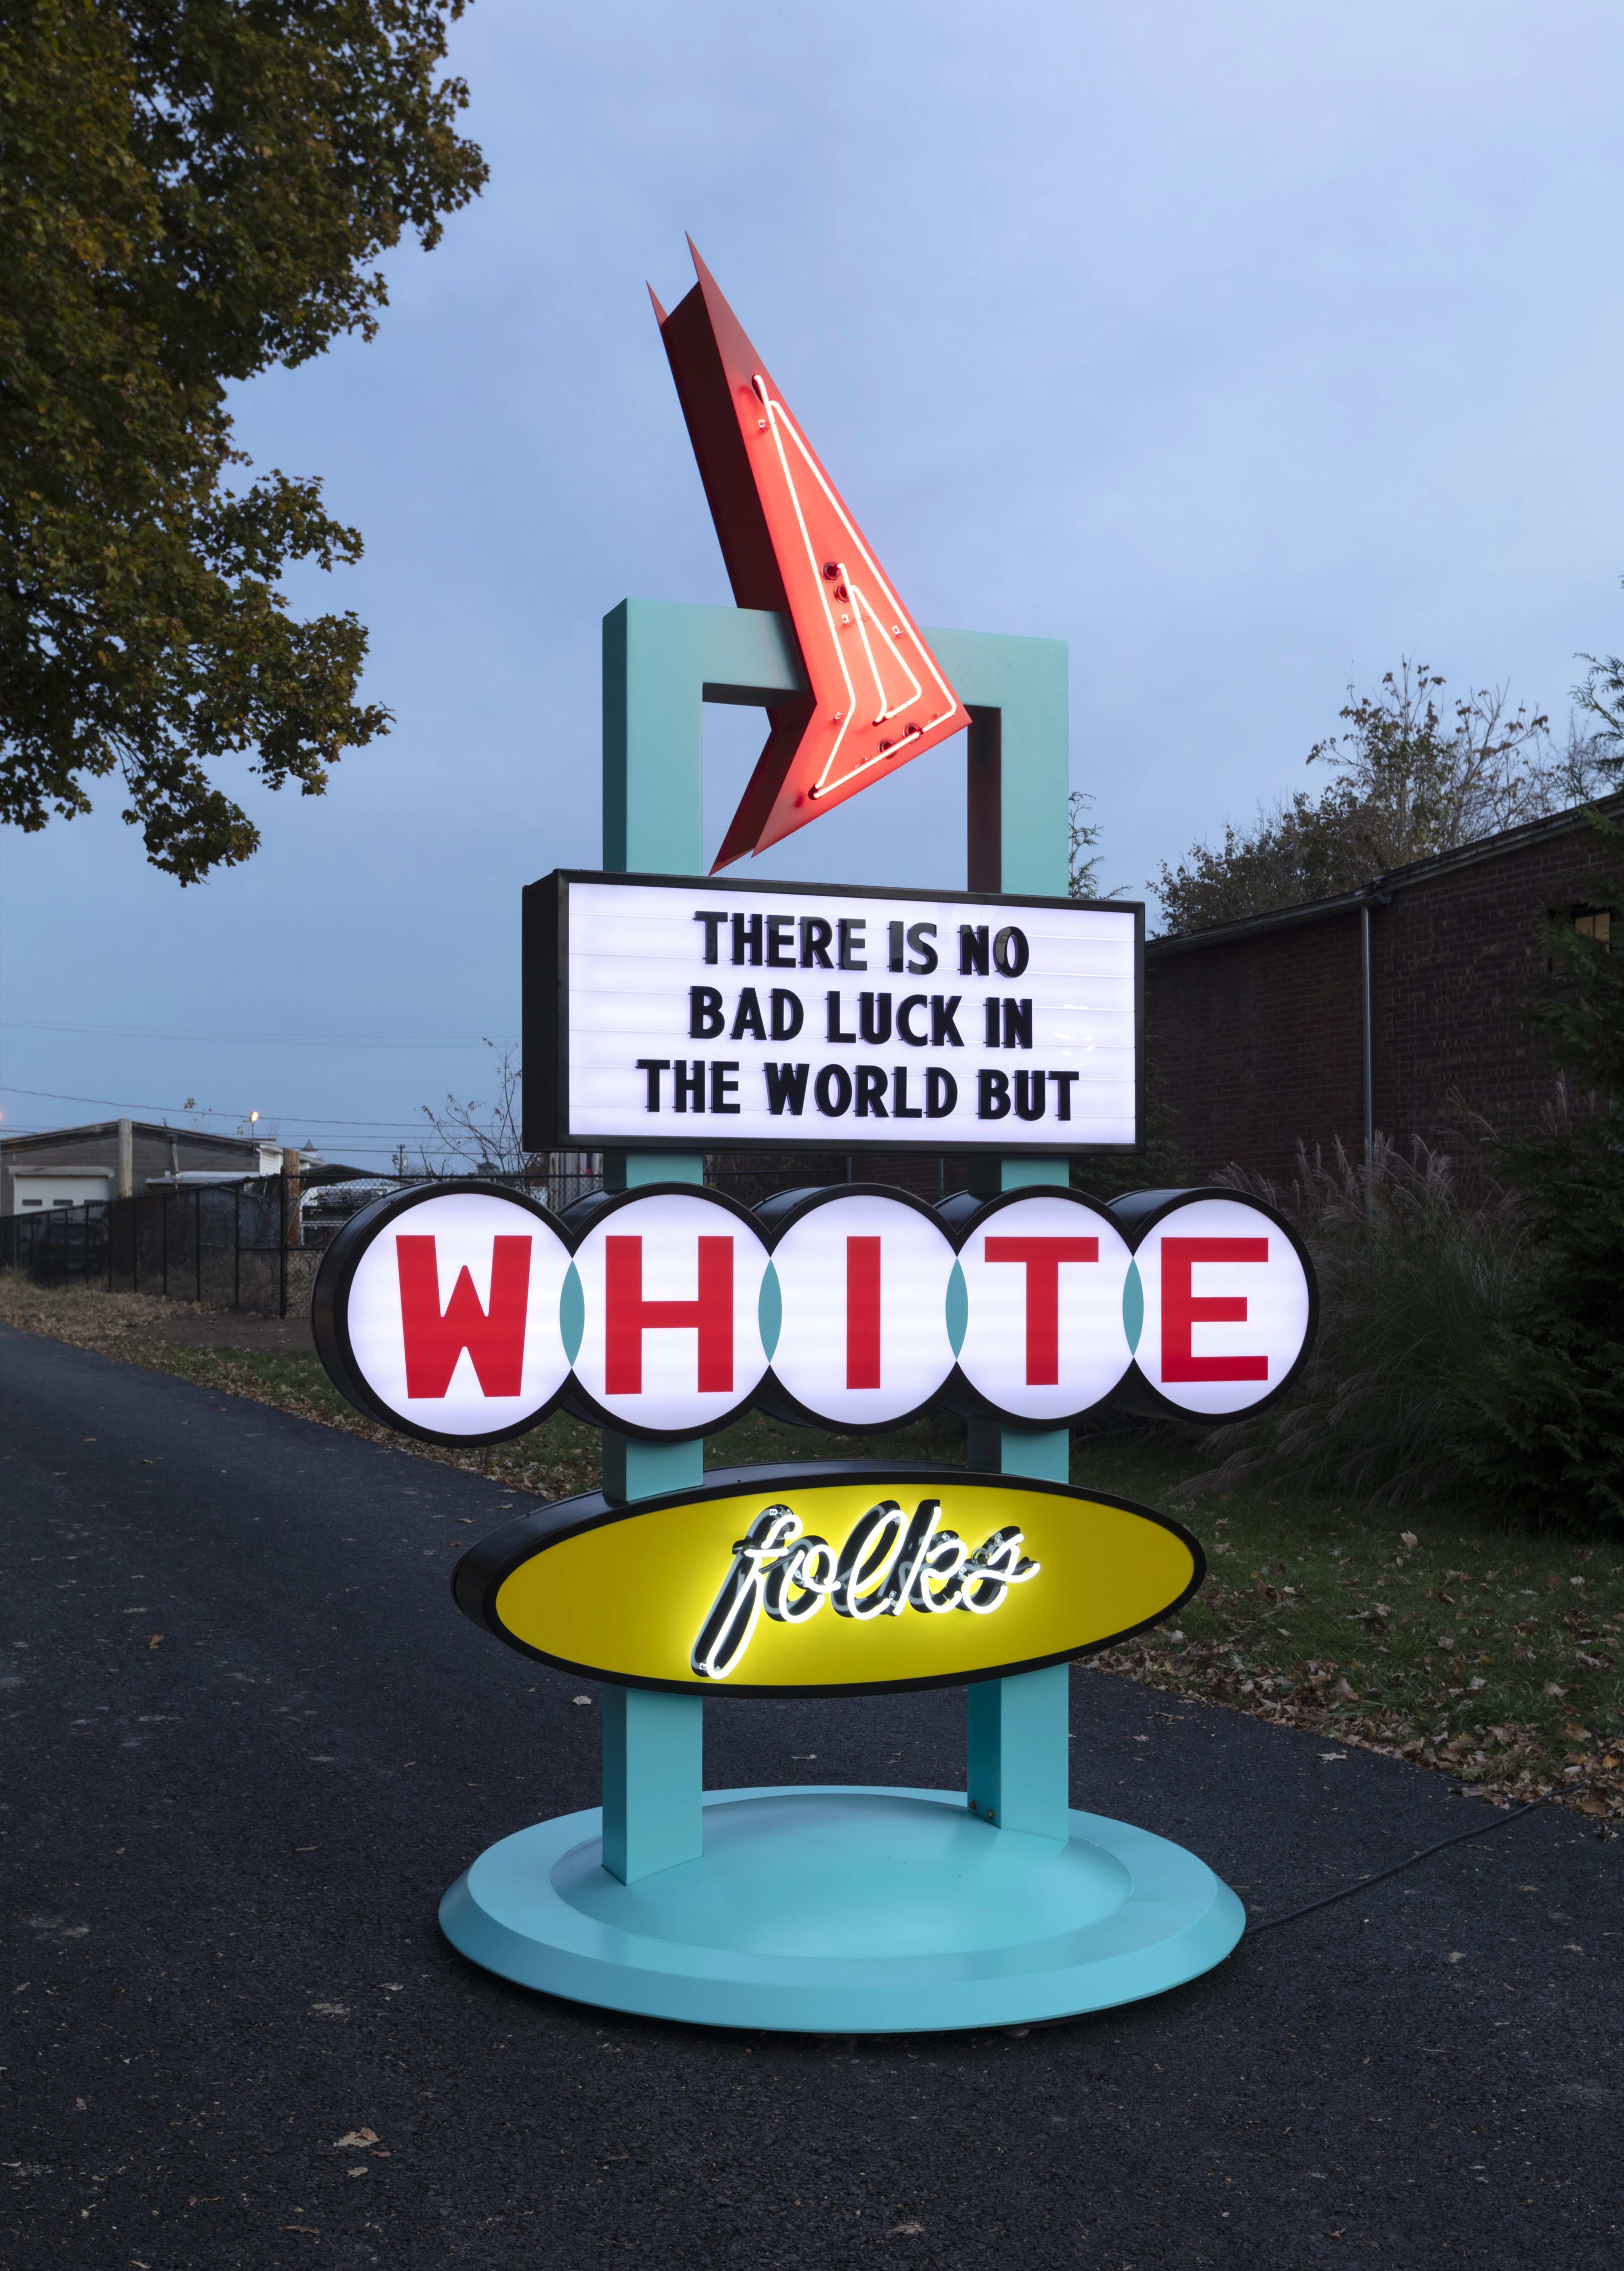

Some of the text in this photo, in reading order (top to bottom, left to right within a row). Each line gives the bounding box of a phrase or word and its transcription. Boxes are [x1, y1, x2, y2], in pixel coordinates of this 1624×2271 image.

[693, 911, 1029, 978] THERE IS NO
[688, 986, 1032, 1049] BAD LUCK IN
[635, 1059, 1079, 1121] THE WORLD BUT
[396, 1235, 1268, 1398] WHITE
[689, 1498, 1042, 1680] folks
